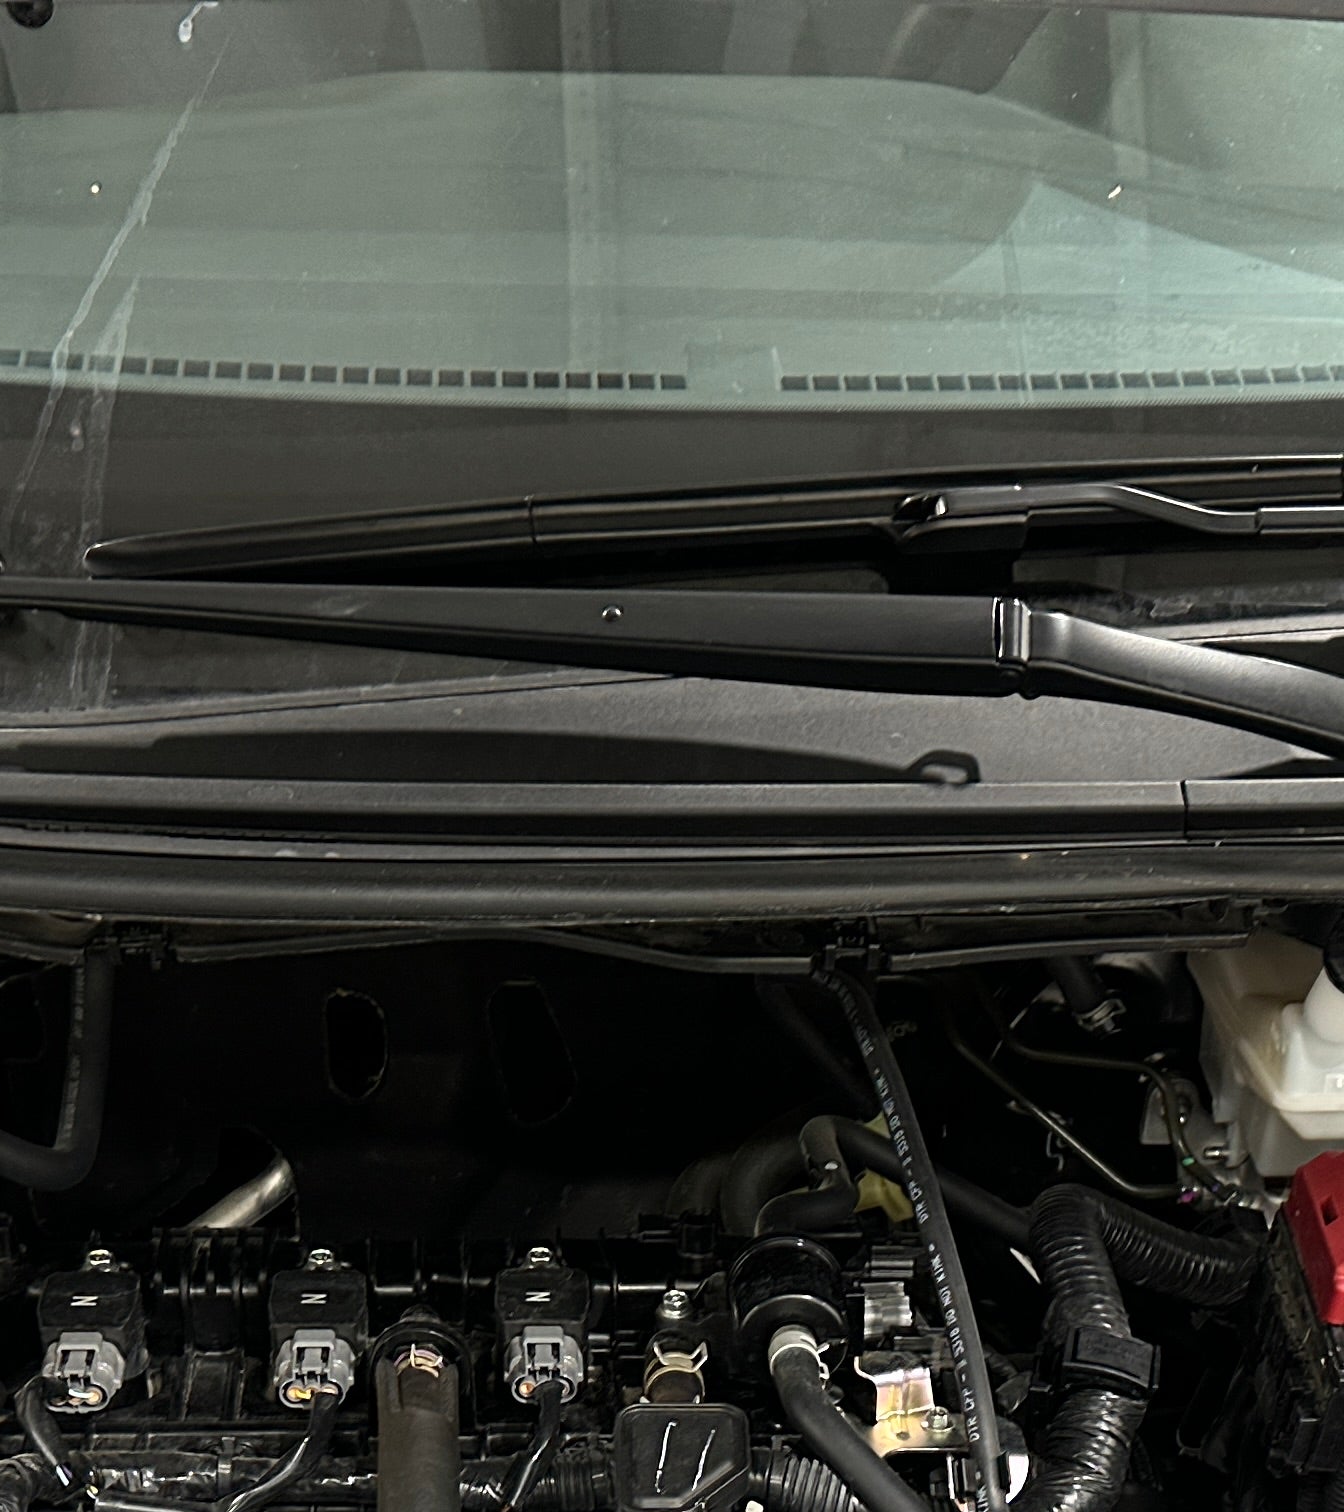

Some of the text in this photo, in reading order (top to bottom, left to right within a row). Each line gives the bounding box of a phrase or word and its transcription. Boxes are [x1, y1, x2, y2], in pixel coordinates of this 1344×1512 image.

[874, 1077, 891, 1098] KINK
[883, 1098, 896, 1114] NOT
[887, 1114, 902, 1128] DO
[912, 1200, 930, 1224] DTR
[929, 1254, 949, 1283] KINK
[938, 1286, 953, 1305] NOT
[944, 1308, 957, 1325] DO
[966, 1416, 981, 1441] DTR
